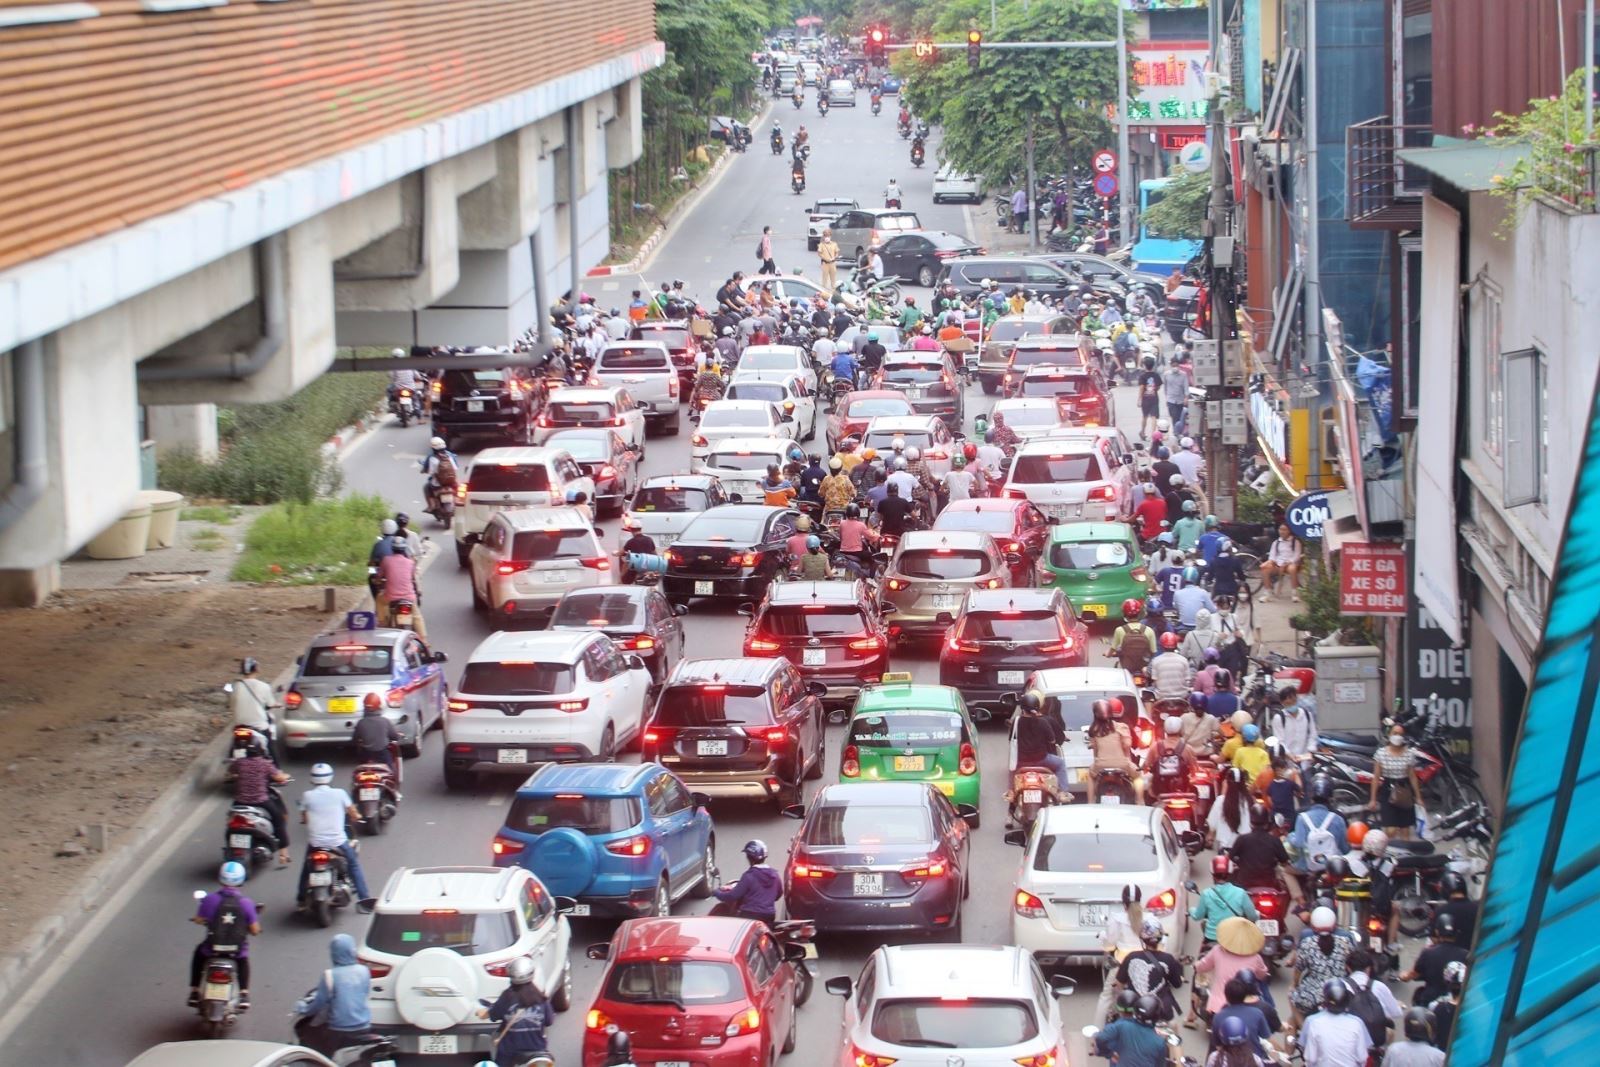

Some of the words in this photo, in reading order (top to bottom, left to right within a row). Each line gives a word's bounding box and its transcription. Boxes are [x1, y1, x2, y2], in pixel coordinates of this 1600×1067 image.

[915, 42, 933, 57] 04
[1351, 559, 1372, 572] XE
[1375, 559, 1398, 572] GA
[1169, 573, 1183, 592] 9
[1351, 577, 1372, 590] XE
[1375, 572, 1397, 591] SỐ
[1343, 593, 1364, 606] XE
[1366, 591, 1405, 610] ĐIỆN
